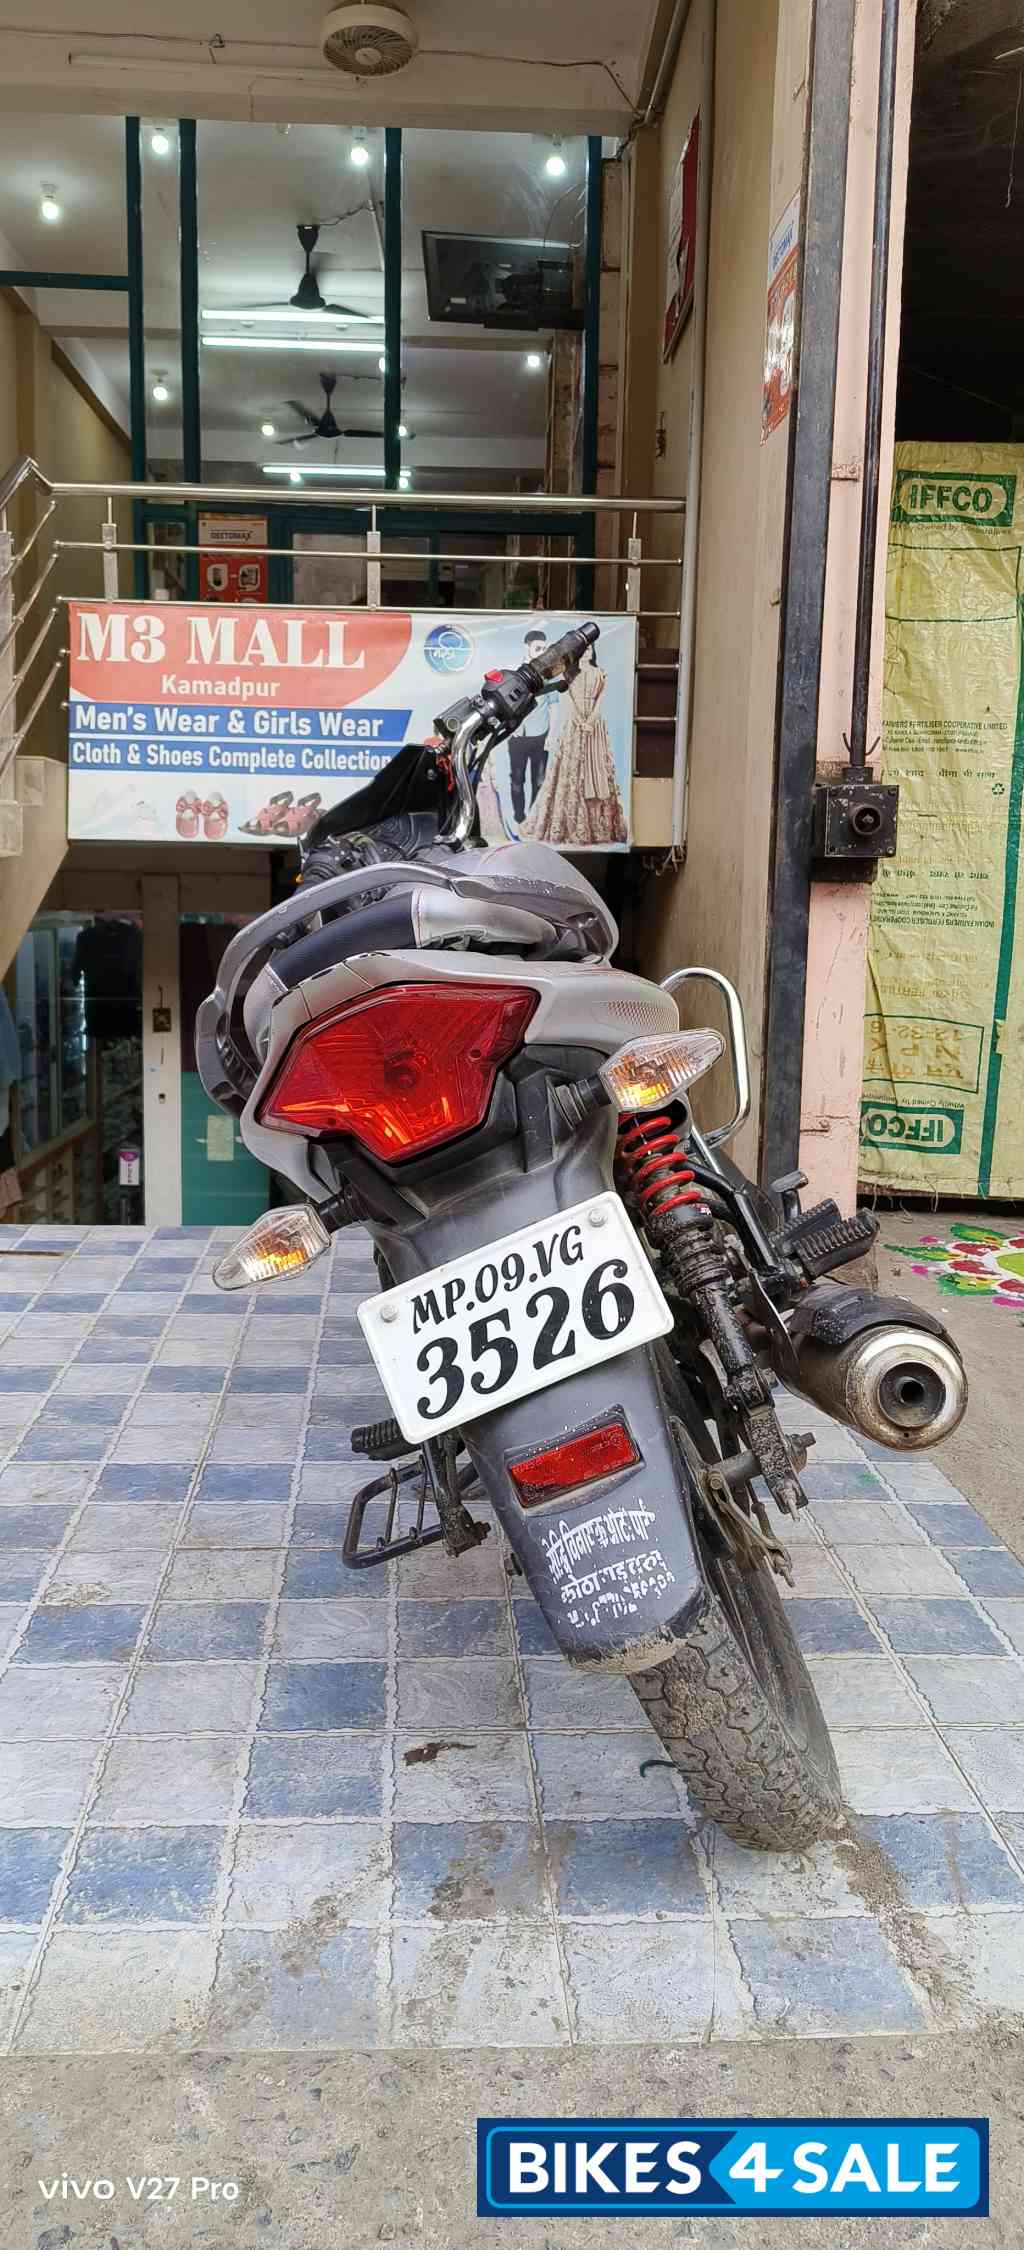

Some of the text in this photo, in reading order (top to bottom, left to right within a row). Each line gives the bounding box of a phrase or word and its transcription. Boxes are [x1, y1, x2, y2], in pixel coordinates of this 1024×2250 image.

[910, 484, 993, 513] IFFCO
[76, 612, 365, 669] M3 MALL
[161, 674, 281, 701] Kamadpur
[75, 705, 384, 738] Men's Wear & Girls Wear
[943, 720, 983, 730] COOPERATIVE
[983, 722, 1008, 730] LIMITED
[72, 741, 123, 764] Cloth
[127, 743, 141, 765] &
[147, 744, 203, 766] Shoes
[208, 745, 295, 773] Complete
[945, 918, 975, 928] FARMERS
[868, 1113, 944, 1142] IFFCO
[411, 1225, 584, 1335] MP.09.VG
[416, 1258, 635, 1420] 3526
